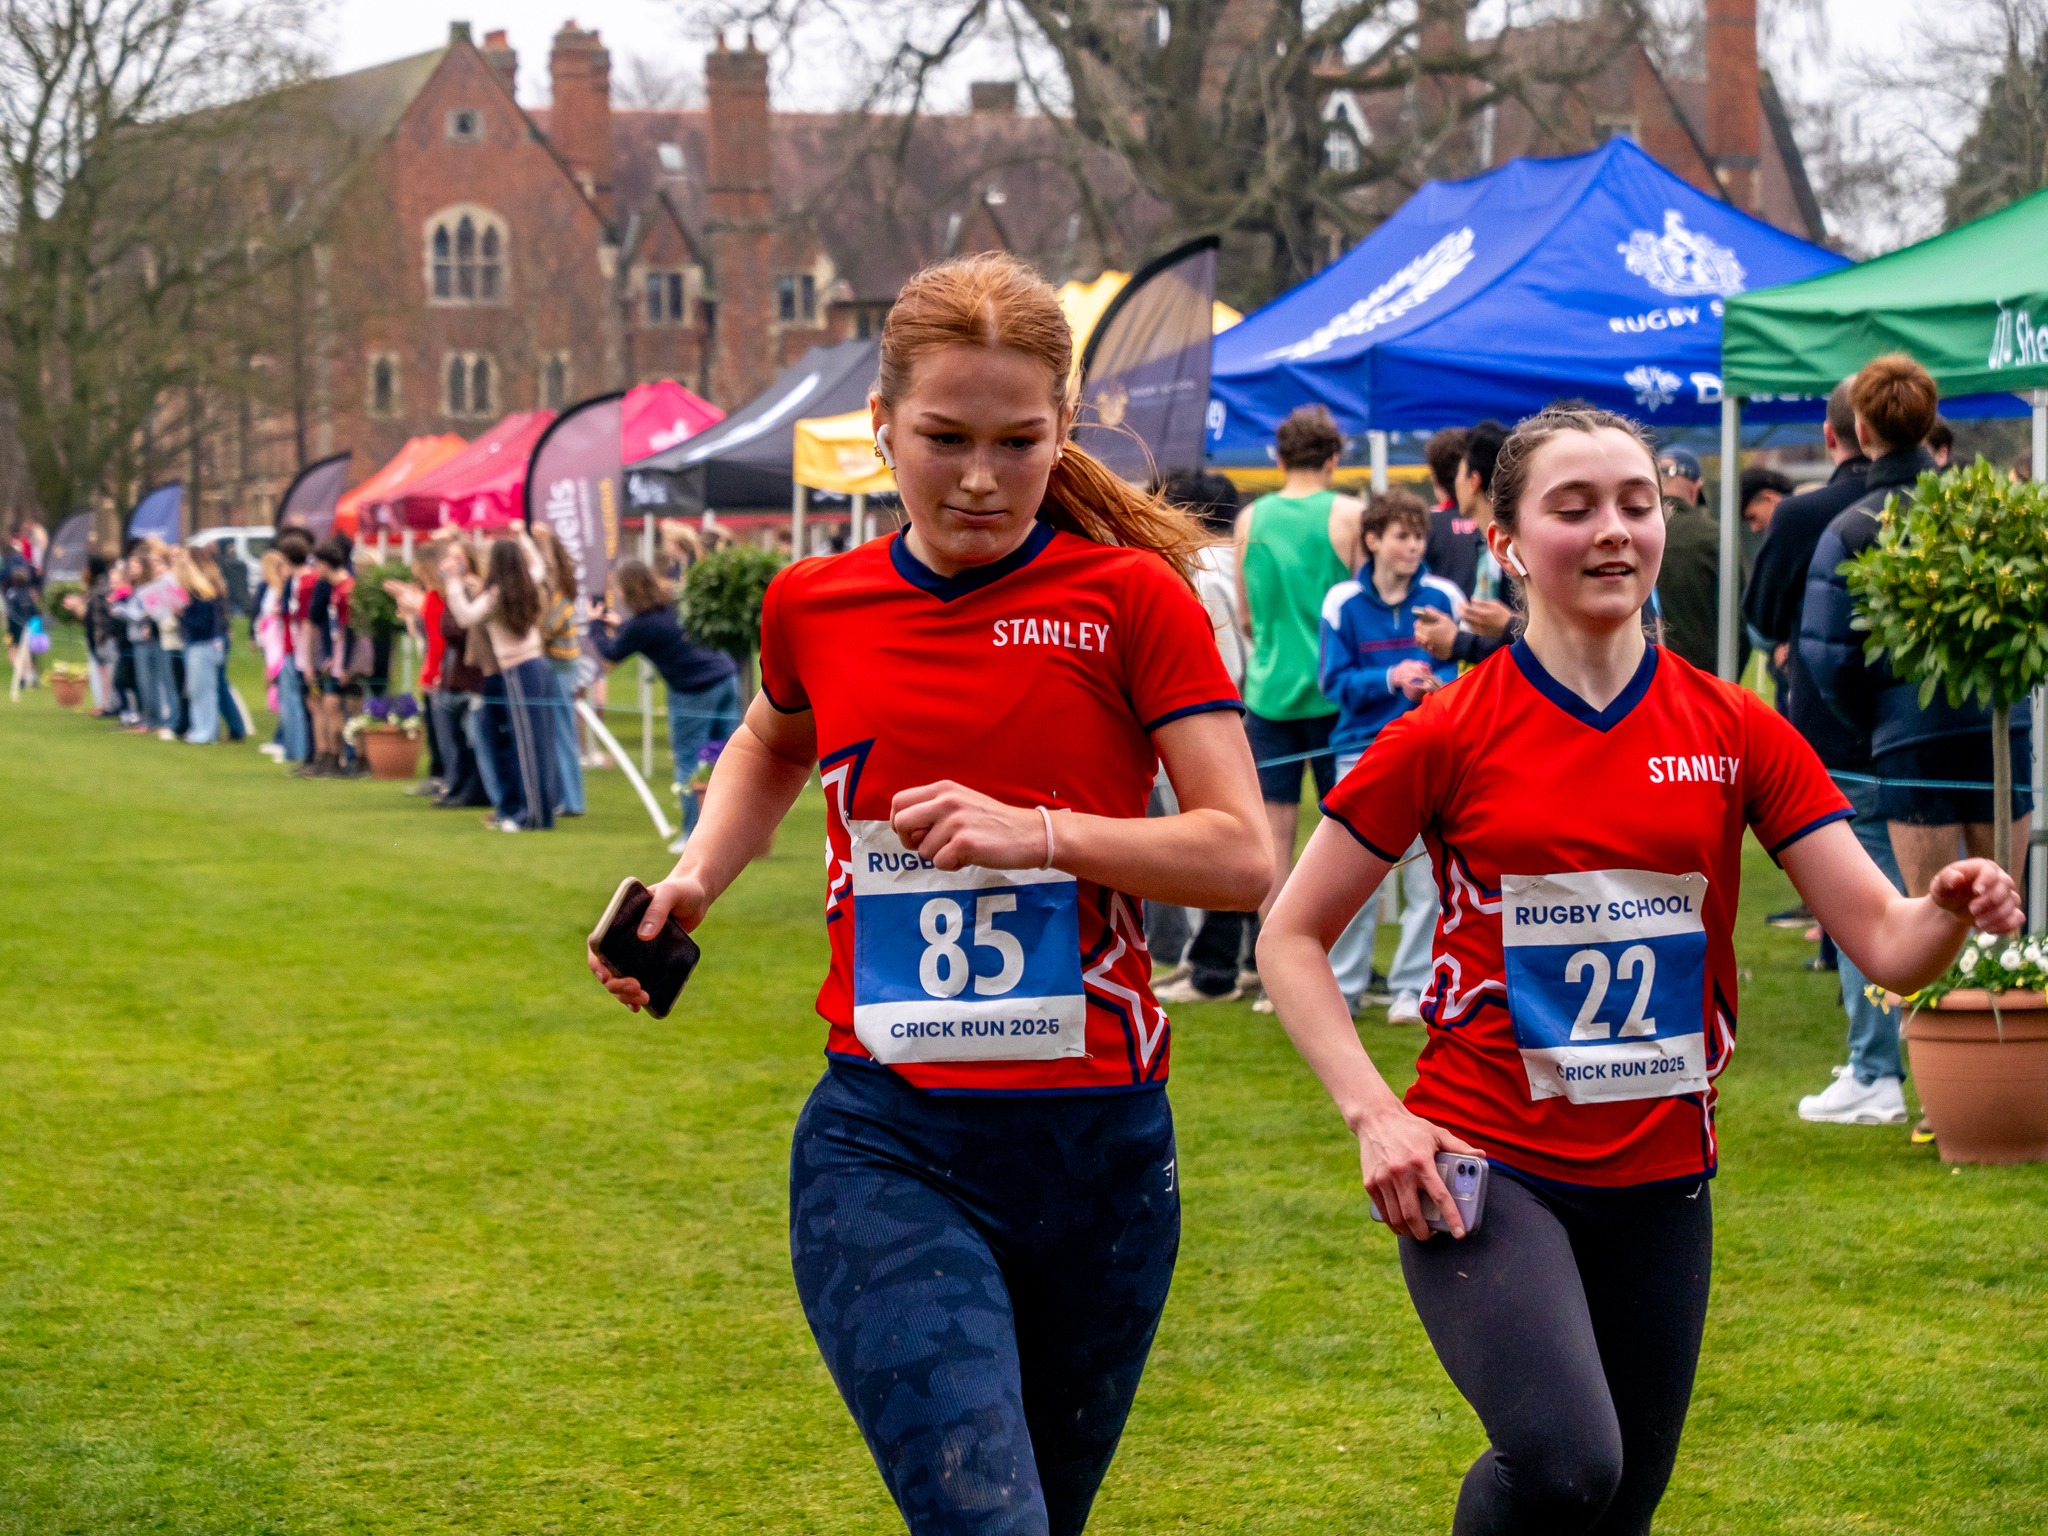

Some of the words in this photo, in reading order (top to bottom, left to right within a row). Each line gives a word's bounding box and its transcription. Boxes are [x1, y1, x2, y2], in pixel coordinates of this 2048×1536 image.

[1608, 304, 1700, 334] RUGBY
[992, 618, 1110, 653] STANLEY
[1647, 754, 1740, 786] STANLEY
[1515, 903, 1602, 926] RUGBY
[1608, 895, 1693, 922] SCHOOL
[918, 893, 1025, 999] 85
[1564, 943, 1658, 1042] 22
[889, 1021, 957, 1039] CRICK
[961, 1020, 1005, 1037] RUN
[1009, 1018, 1060, 1036] 2025
[1556, 1064, 1607, 1082] CRICK
[1610, 1061, 1647, 1079] RUN
[1649, 1056, 1686, 1075] 2025
